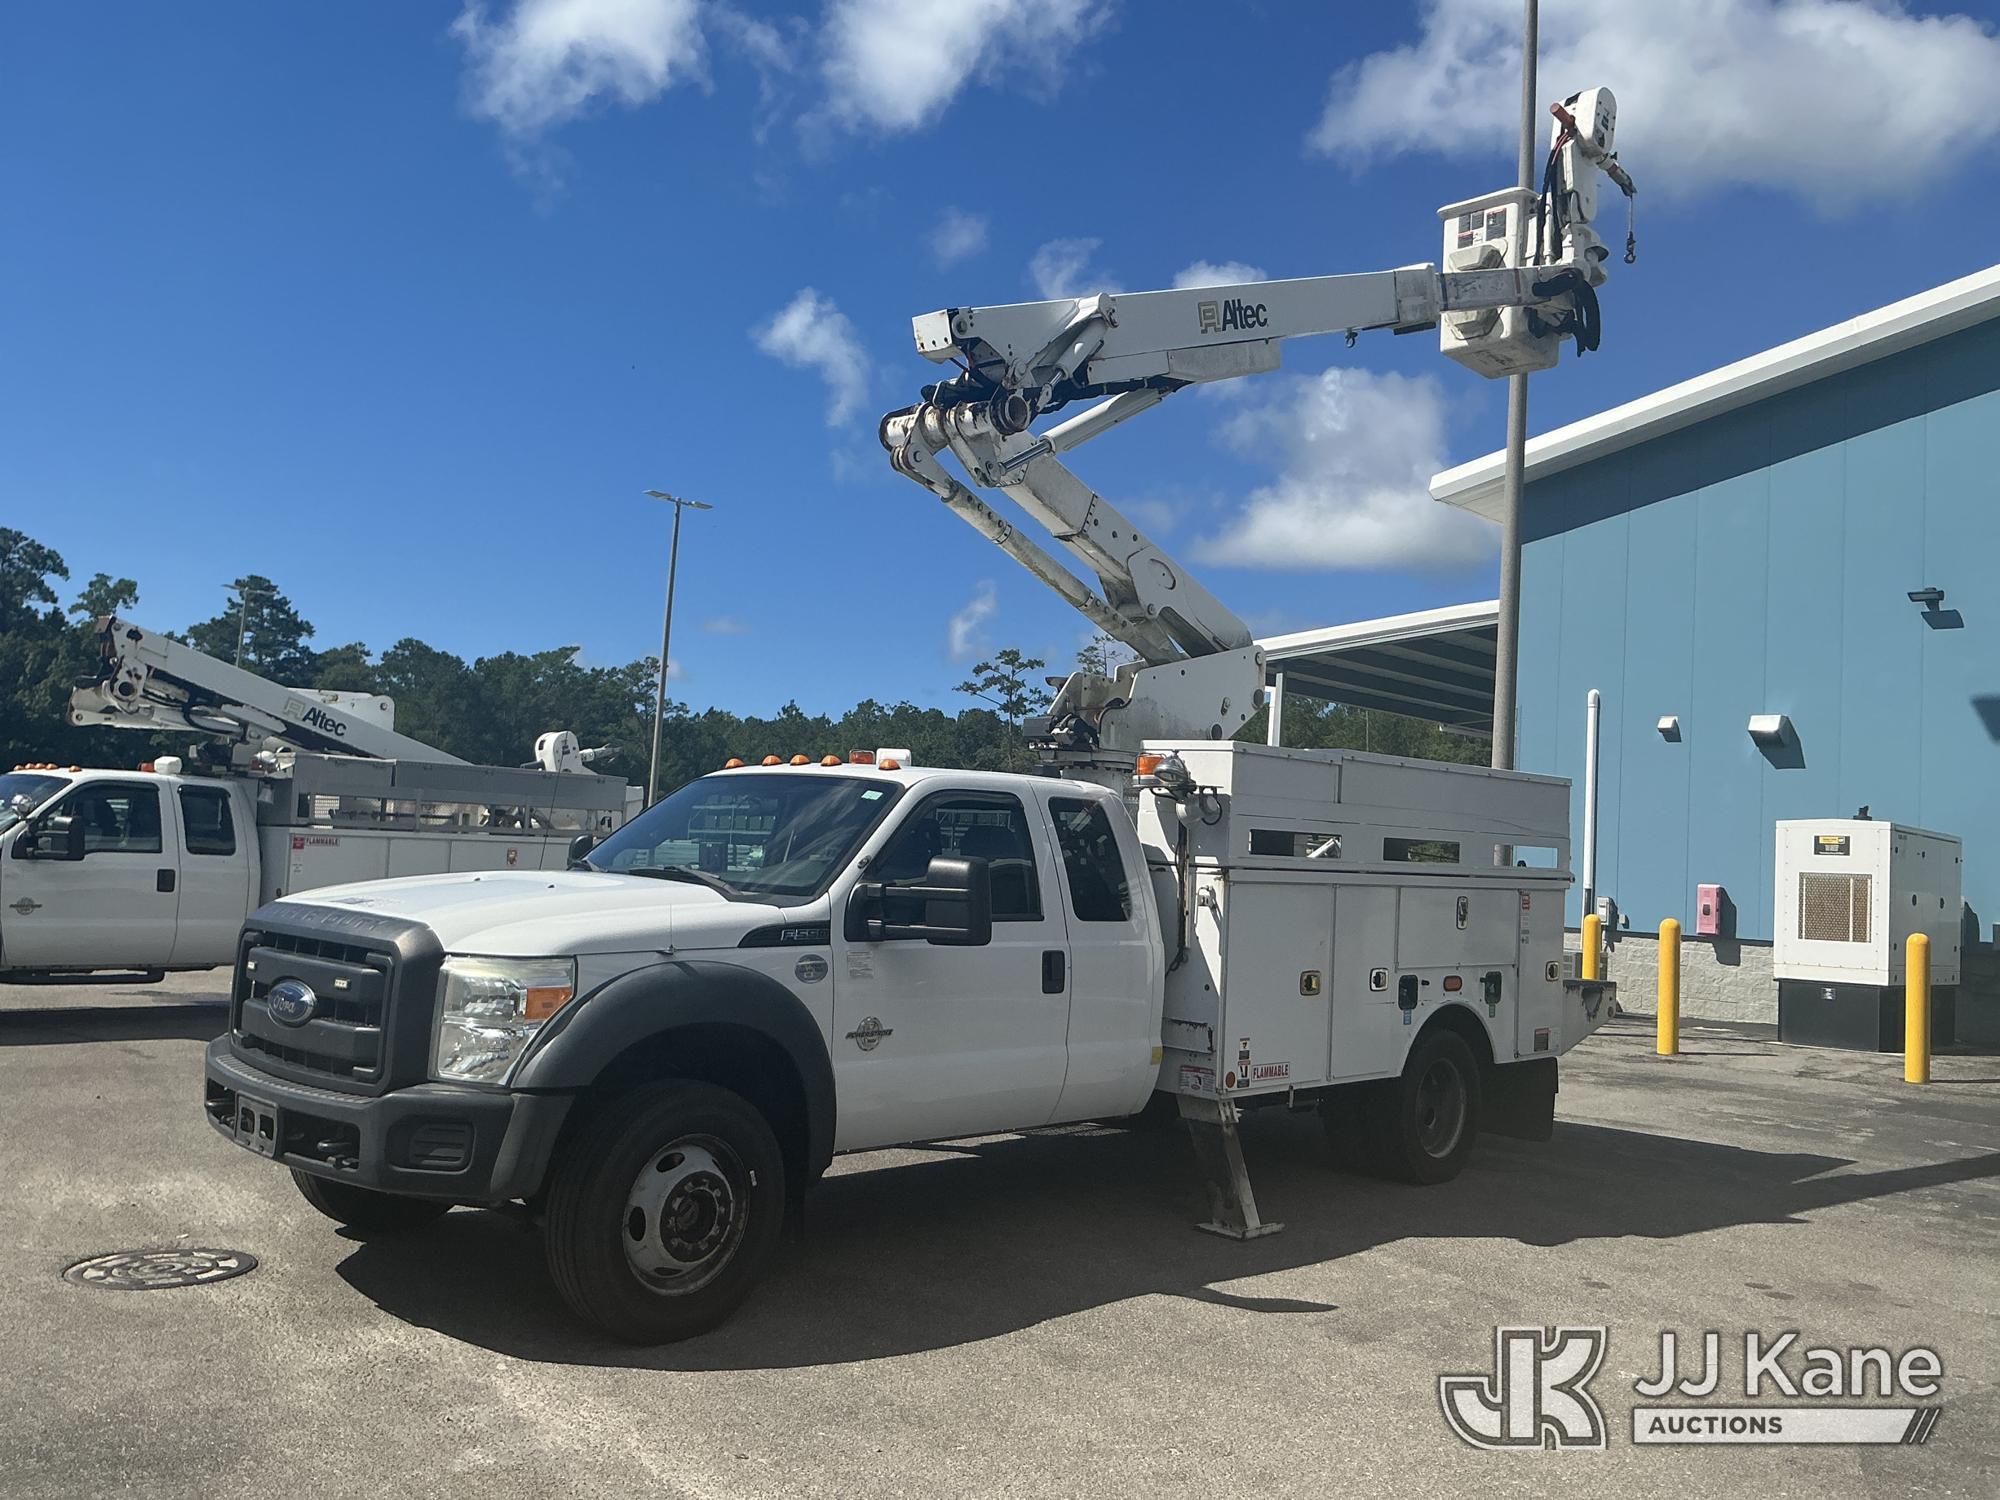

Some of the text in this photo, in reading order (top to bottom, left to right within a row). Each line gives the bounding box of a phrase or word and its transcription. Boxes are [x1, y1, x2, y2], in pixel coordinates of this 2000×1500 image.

[1221, 299, 1269, 332] Altec
[302, 706, 347, 737] Altec
[273, 995, 296, 1014] Ford
[1252, 1063, 1289, 1080] FLAMMABLE
